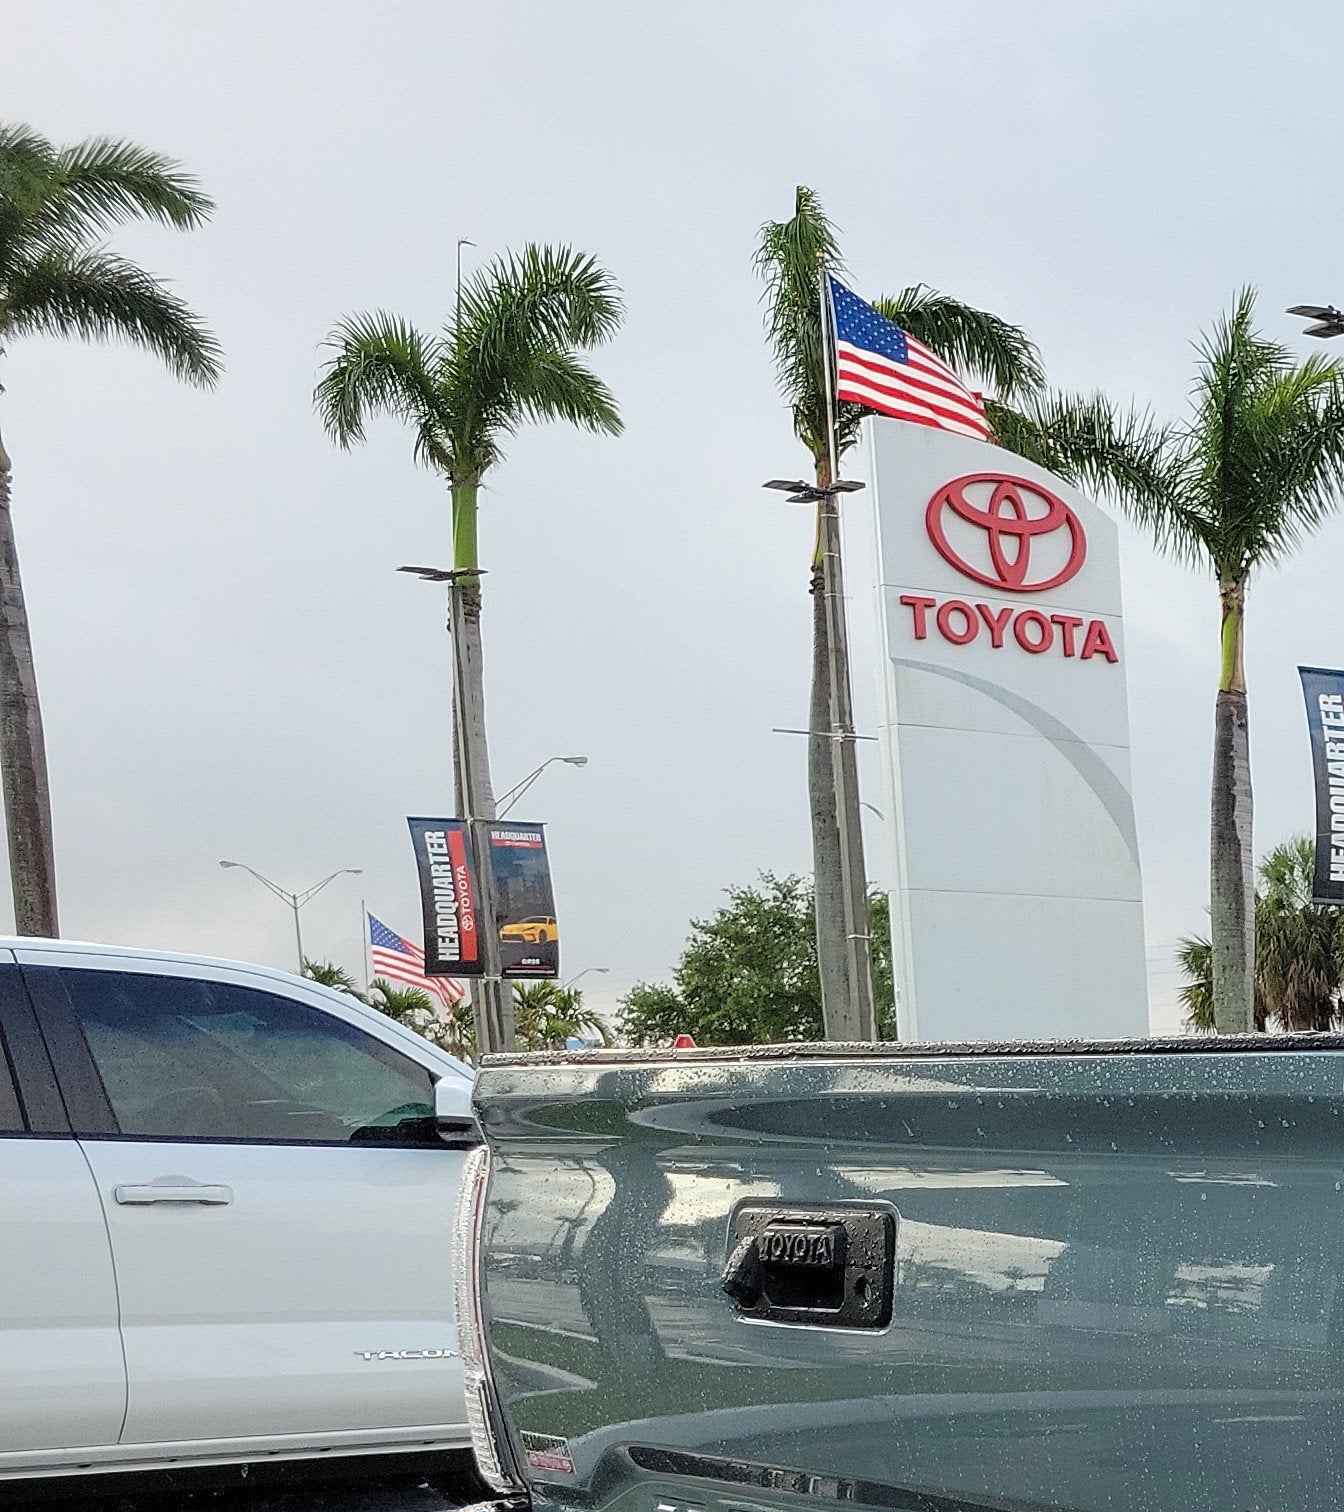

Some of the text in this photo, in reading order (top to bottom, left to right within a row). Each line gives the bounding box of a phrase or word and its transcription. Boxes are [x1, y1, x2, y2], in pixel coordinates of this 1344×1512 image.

[900, 594, 1119, 663] TOYOTA
[491, 830, 541, 841] HEADQUARTER
[425, 831, 460, 961] HEADQUARTER
[457, 865, 474, 914] TOYOTA
[759, 1231, 832, 1265] TOYOTA
